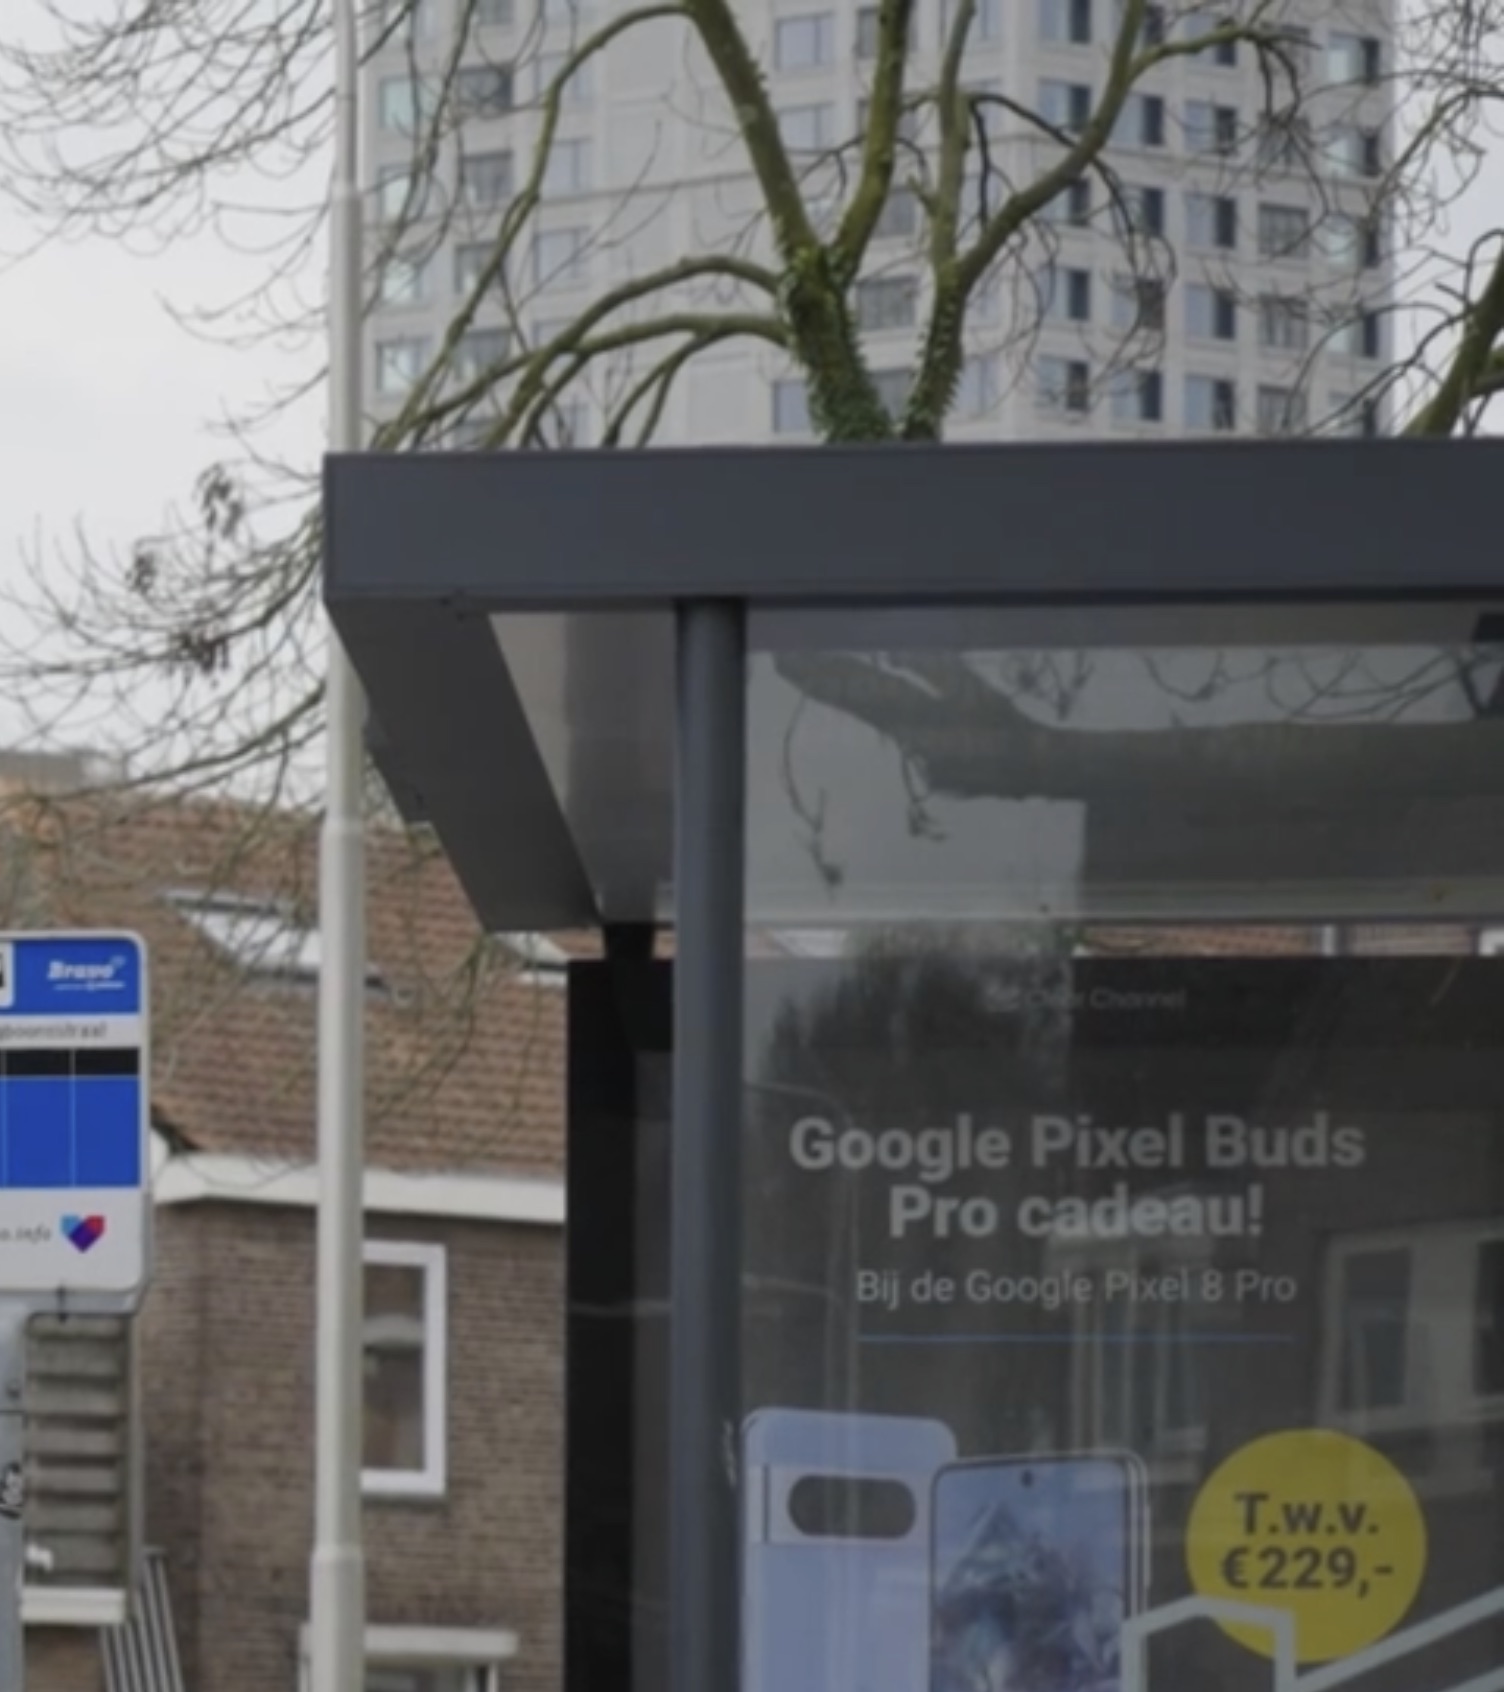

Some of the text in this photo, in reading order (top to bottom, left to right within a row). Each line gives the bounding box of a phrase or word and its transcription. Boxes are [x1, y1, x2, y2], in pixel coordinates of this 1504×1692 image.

[789, 1113, 1366, 1180] Google Pixel Buds
[891, 1184, 1264, 1239] Pro cadeau!
[856, 1270, 1297, 1312] Bij de Google Pixel 8 Pro
[1235, 1493, 1379, 1537] T.w.v.
